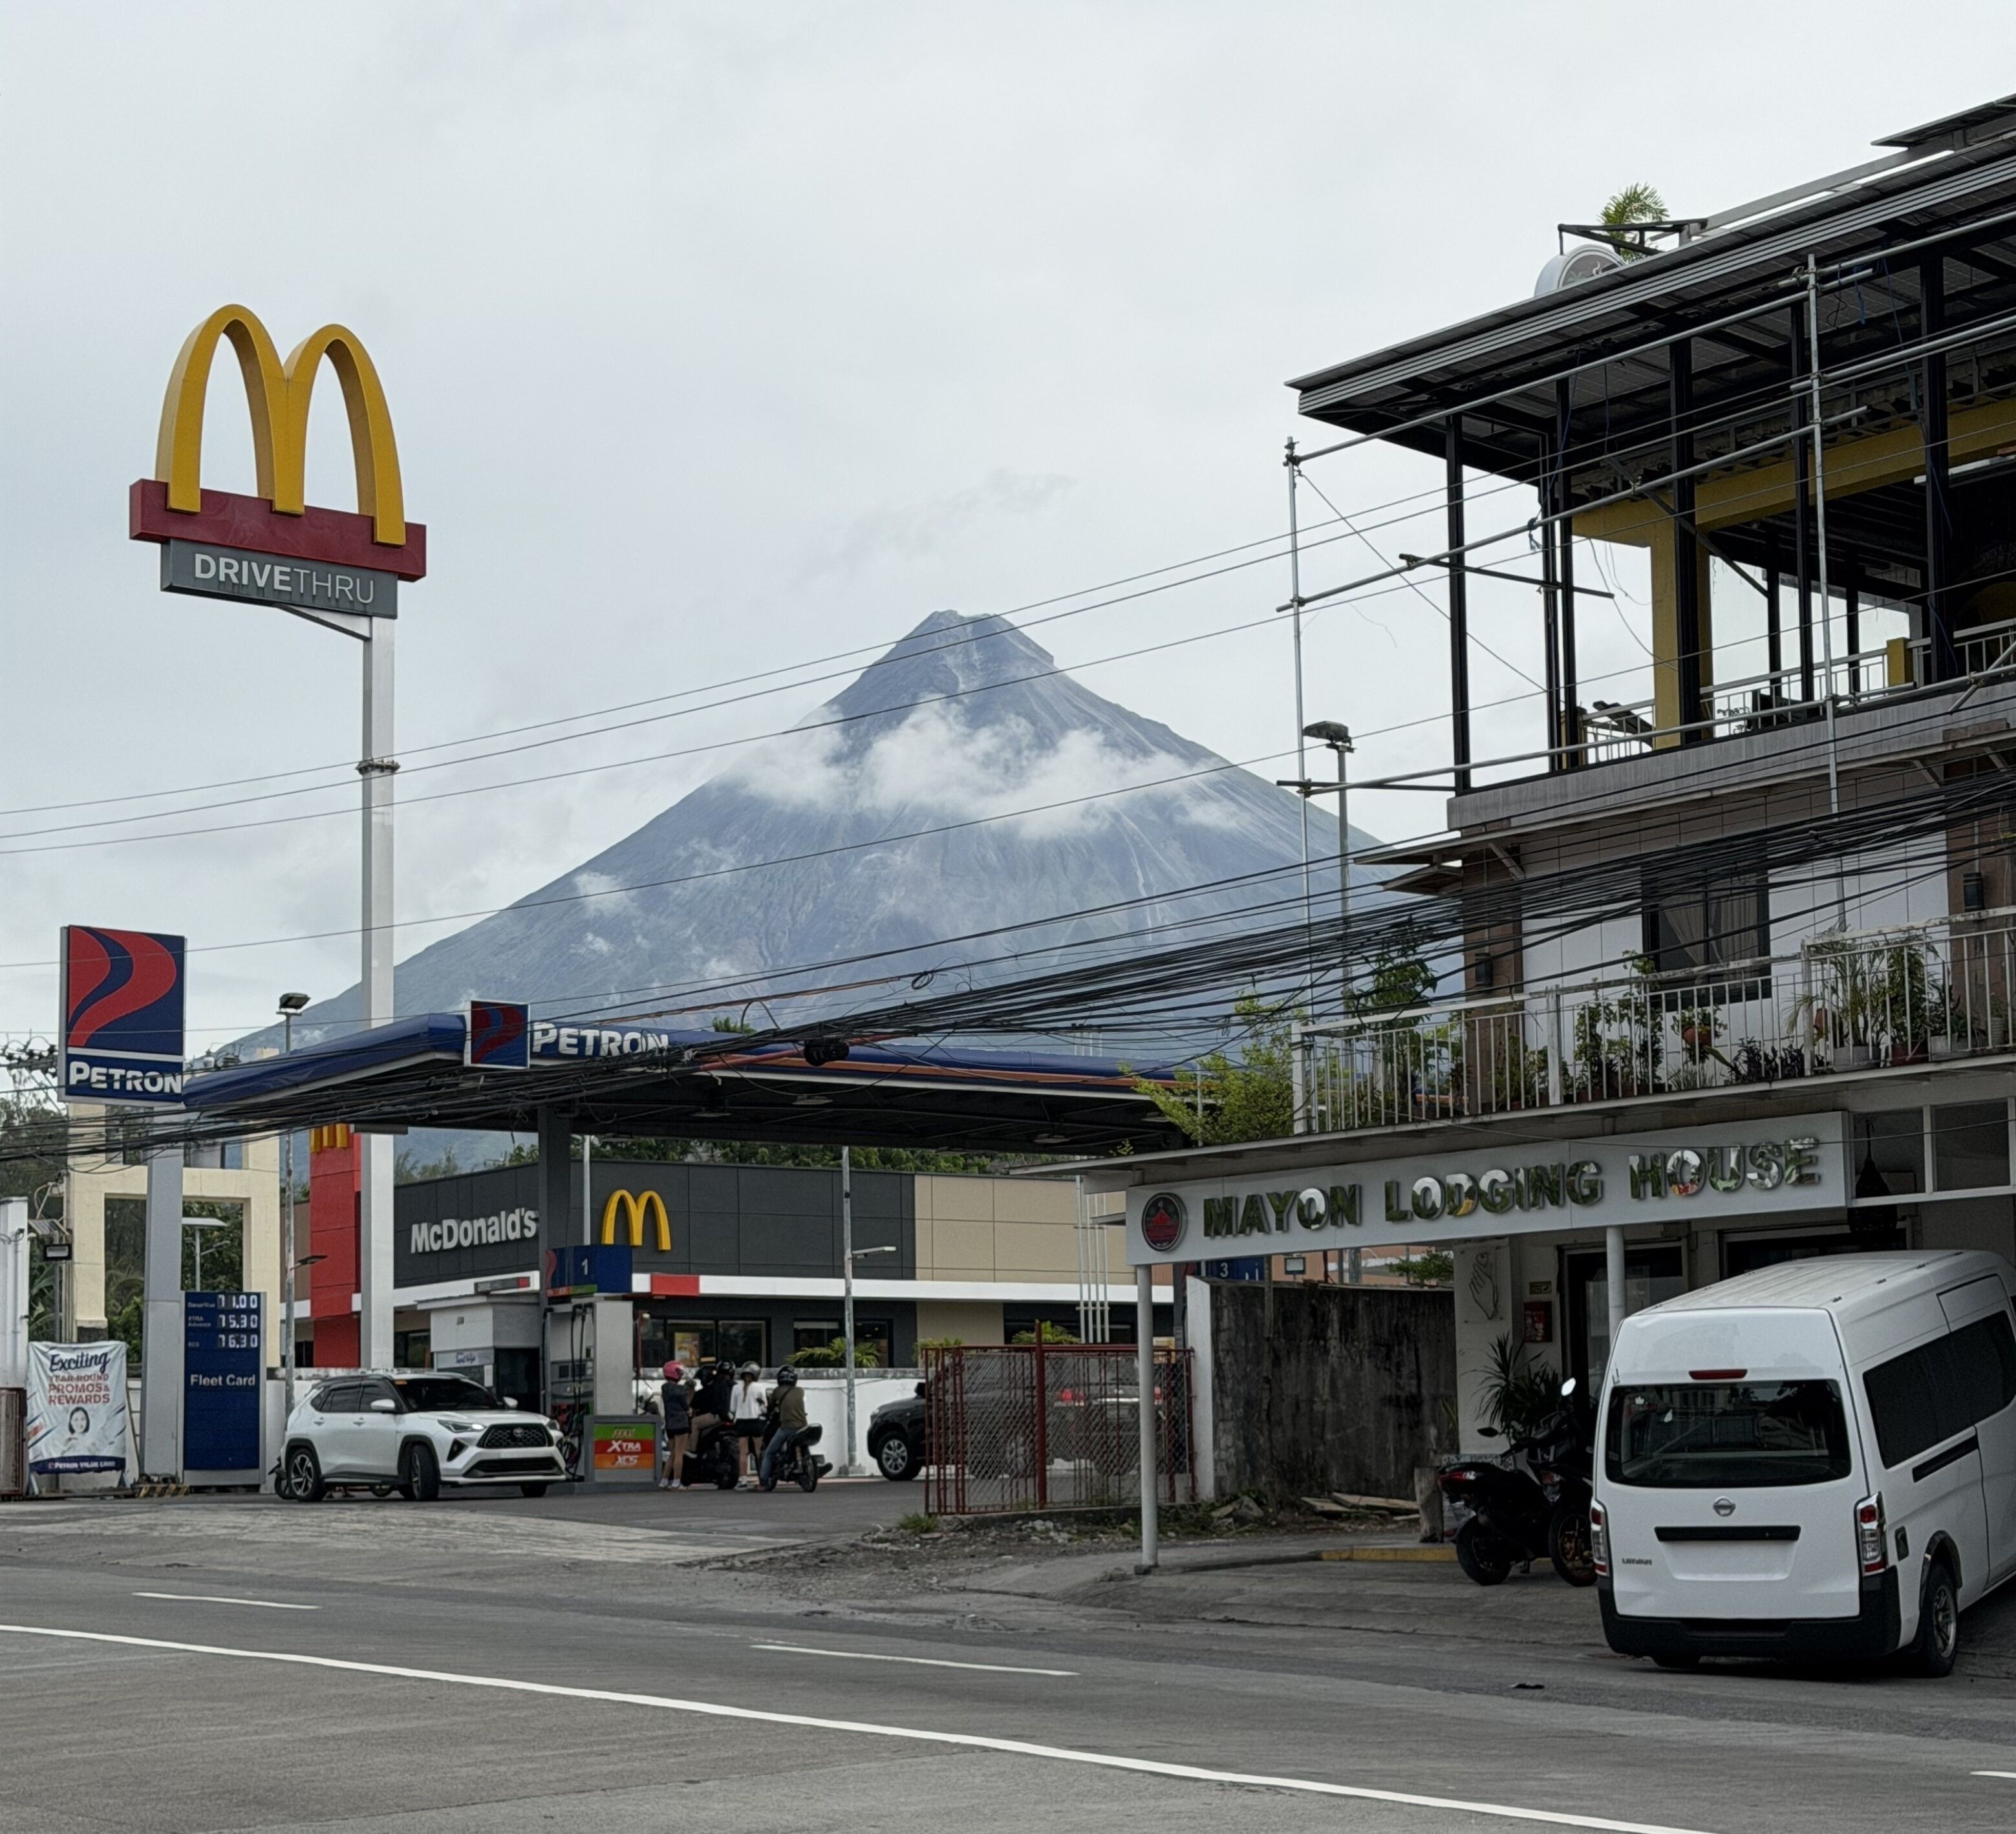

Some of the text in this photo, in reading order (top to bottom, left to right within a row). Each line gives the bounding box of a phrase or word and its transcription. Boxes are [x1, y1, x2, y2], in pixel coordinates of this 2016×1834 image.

[532, 1021, 669, 1056] PETRON
[69, 1061, 182, 1094] PETRON
[1203, 1137, 1821, 1239] MAYON LODGING HOUSE
[411, 1207, 537, 1253] McDonald's
[581, 1258, 588, 1275] 1
[1220, 1262, 1228, 1278] 3
[49, 1352, 111, 1374] Exciting
[48, 1383, 102, 1393] PROMOS
[190, 1374, 256, 1386] Fleet Card
[48, 1394, 110, 1405] REWARDS
